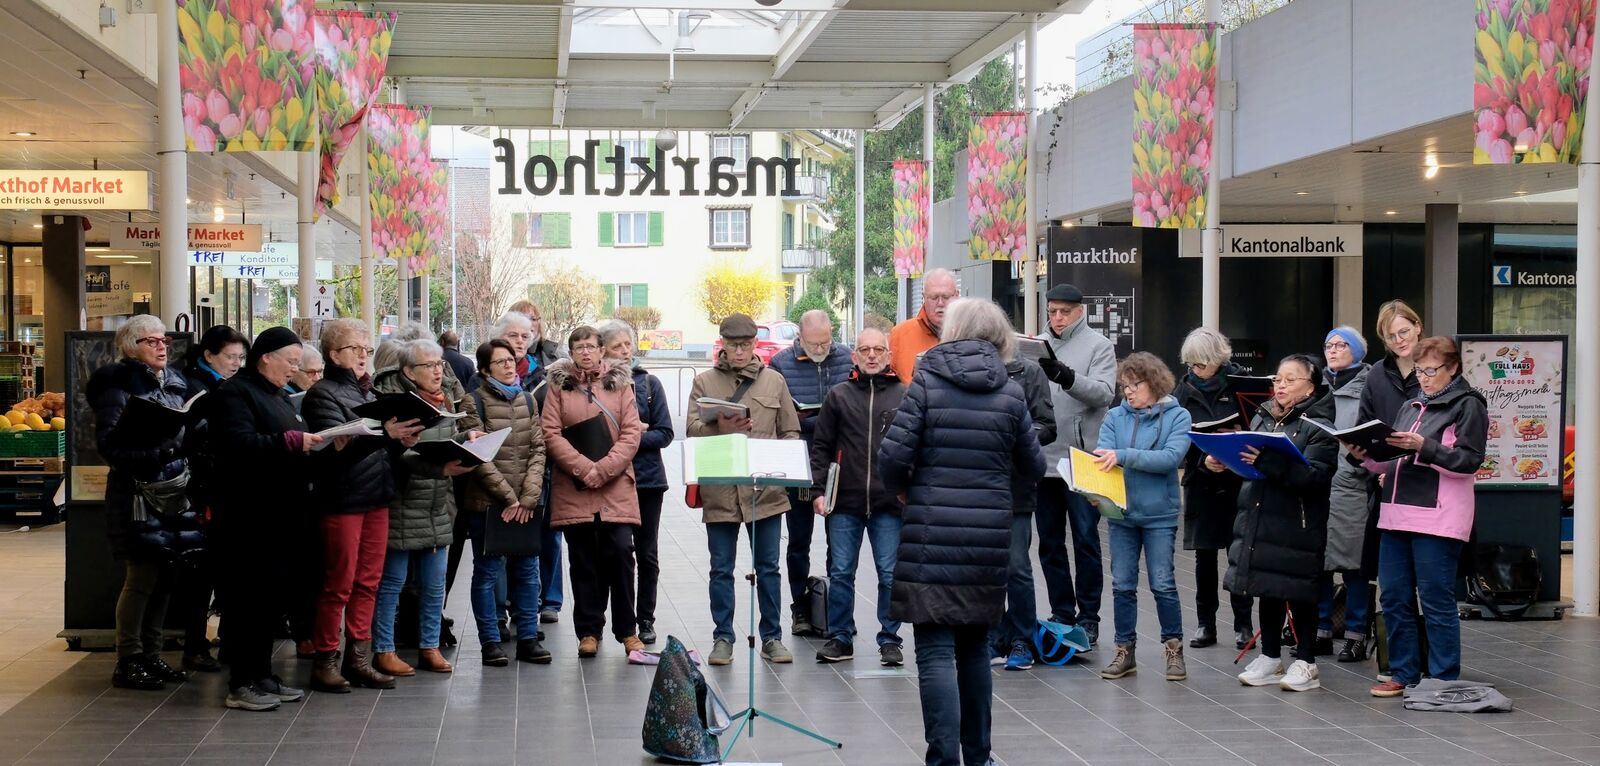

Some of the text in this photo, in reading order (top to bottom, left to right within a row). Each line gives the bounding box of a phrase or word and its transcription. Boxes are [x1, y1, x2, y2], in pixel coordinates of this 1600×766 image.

[52, 177, 123, 193] Market
[54, 197, 105, 206] genussvoll
[194, 228, 245, 241] Market
[1231, 236, 1345, 253] Kantonalbank
[240, 254, 289, 263] Konditorei
[1056, 248, 1137, 264] markthof
